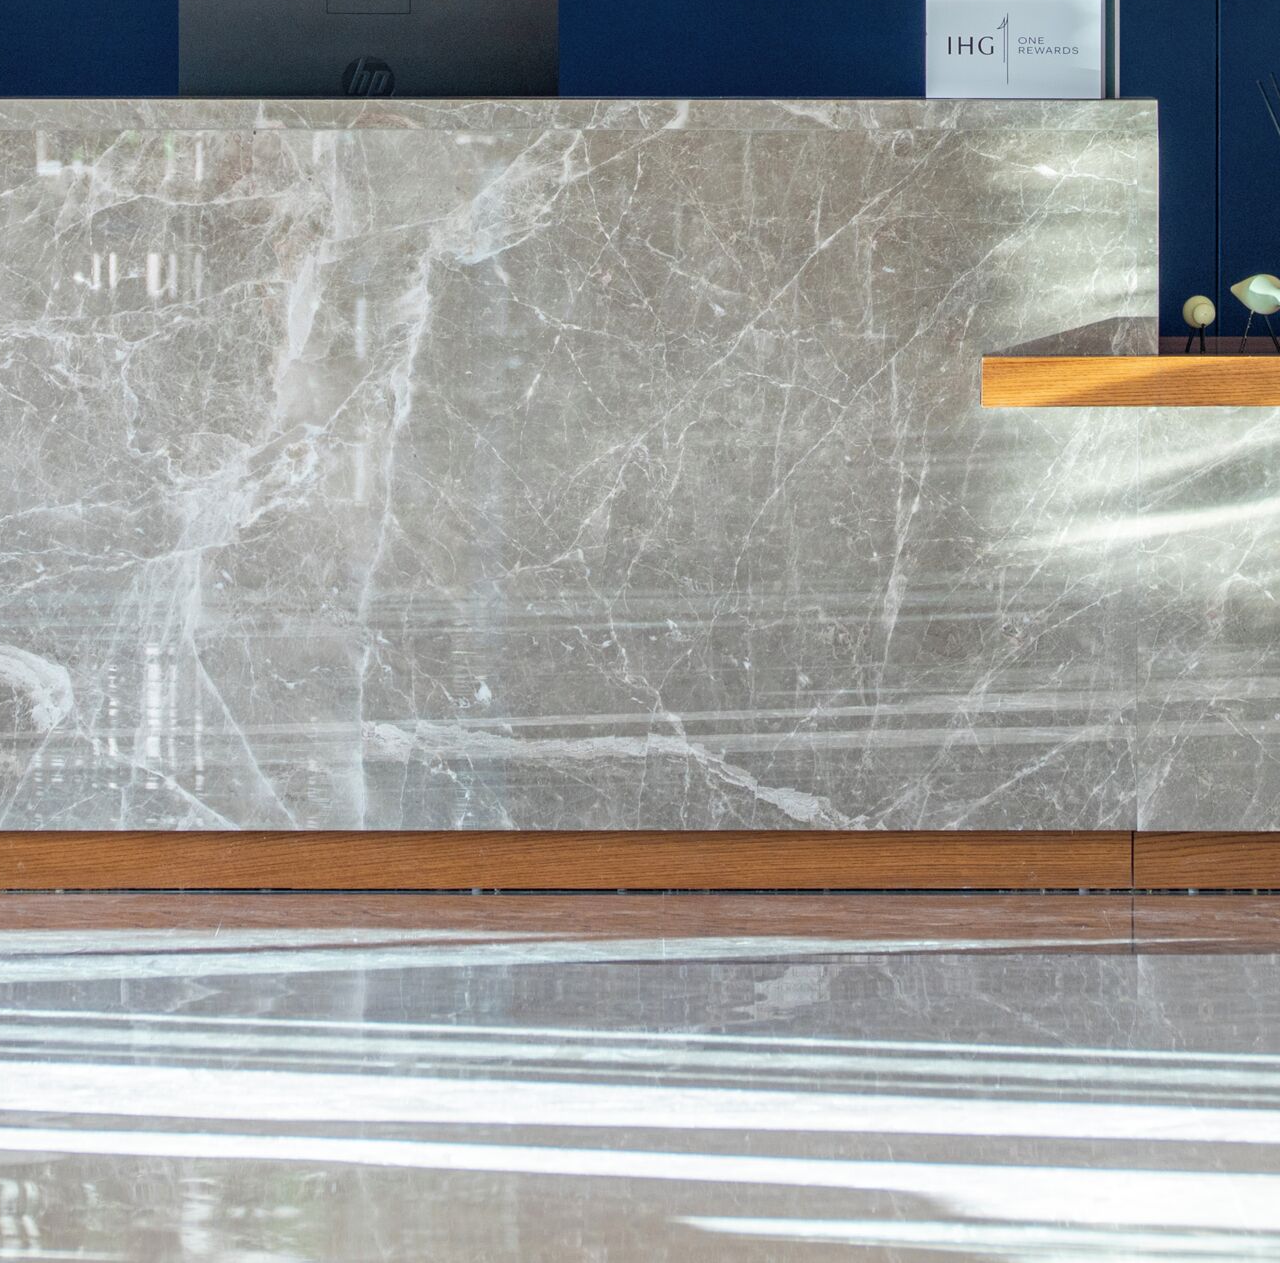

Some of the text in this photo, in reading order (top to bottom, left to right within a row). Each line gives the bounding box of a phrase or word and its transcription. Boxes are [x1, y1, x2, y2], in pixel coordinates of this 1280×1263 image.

[948, 36, 994, 55] IHG
[1018, 36, 1045, 45] ONE
[1018, 46, 1079, 55] REWARDS
[348, 57, 392, 97] hp
